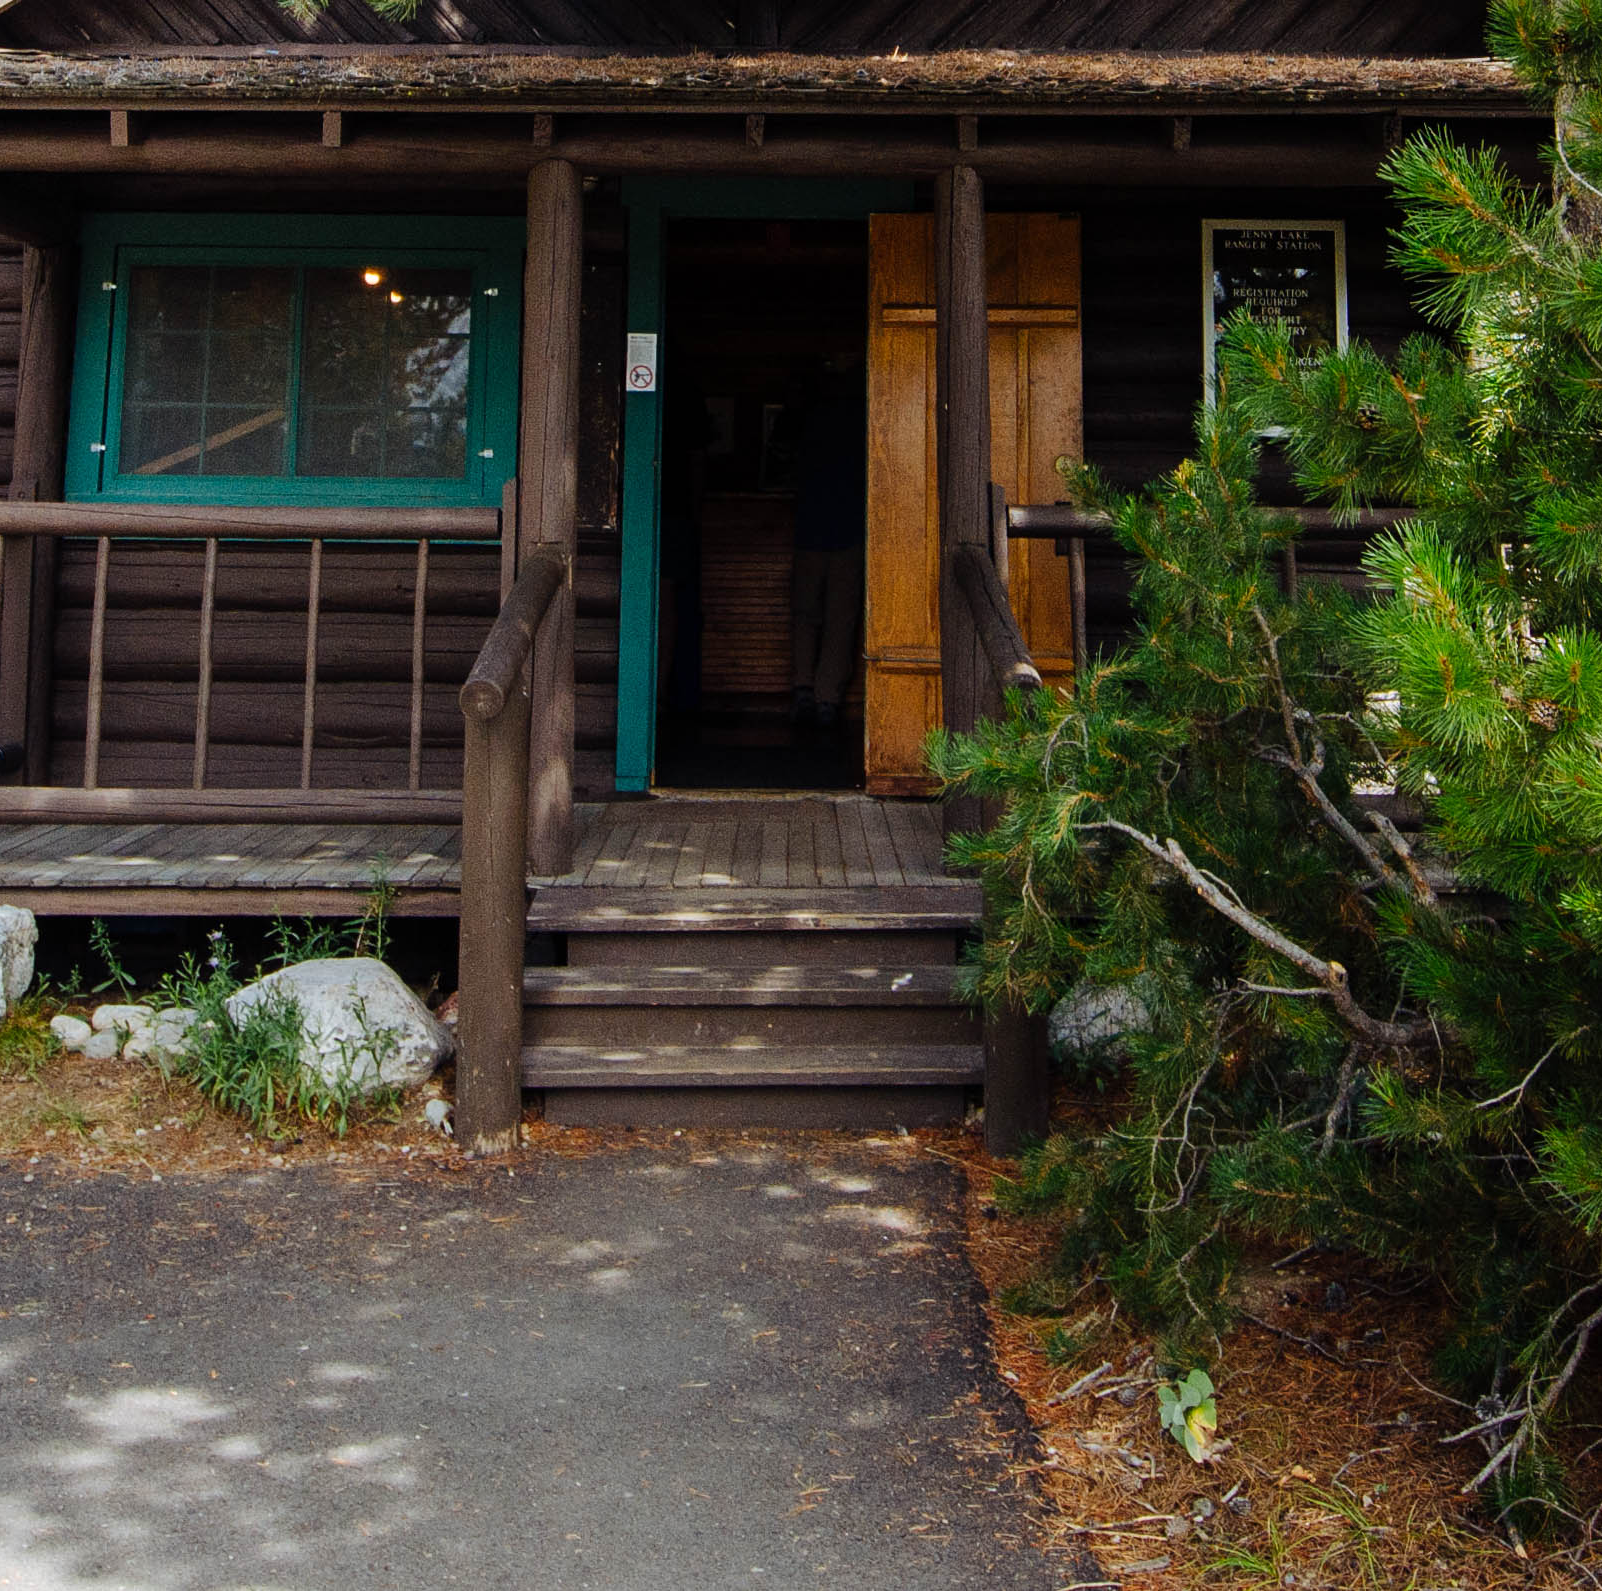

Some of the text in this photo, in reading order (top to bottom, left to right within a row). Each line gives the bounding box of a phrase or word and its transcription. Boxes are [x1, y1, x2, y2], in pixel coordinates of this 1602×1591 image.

[1241, 231, 1310, 240] JENNY LAKE
[1224, 240, 1322, 251] RANGER STATION
[1233, 288, 1309, 298] REGISTRATION
[1261, 307, 1281, 316] FOR
